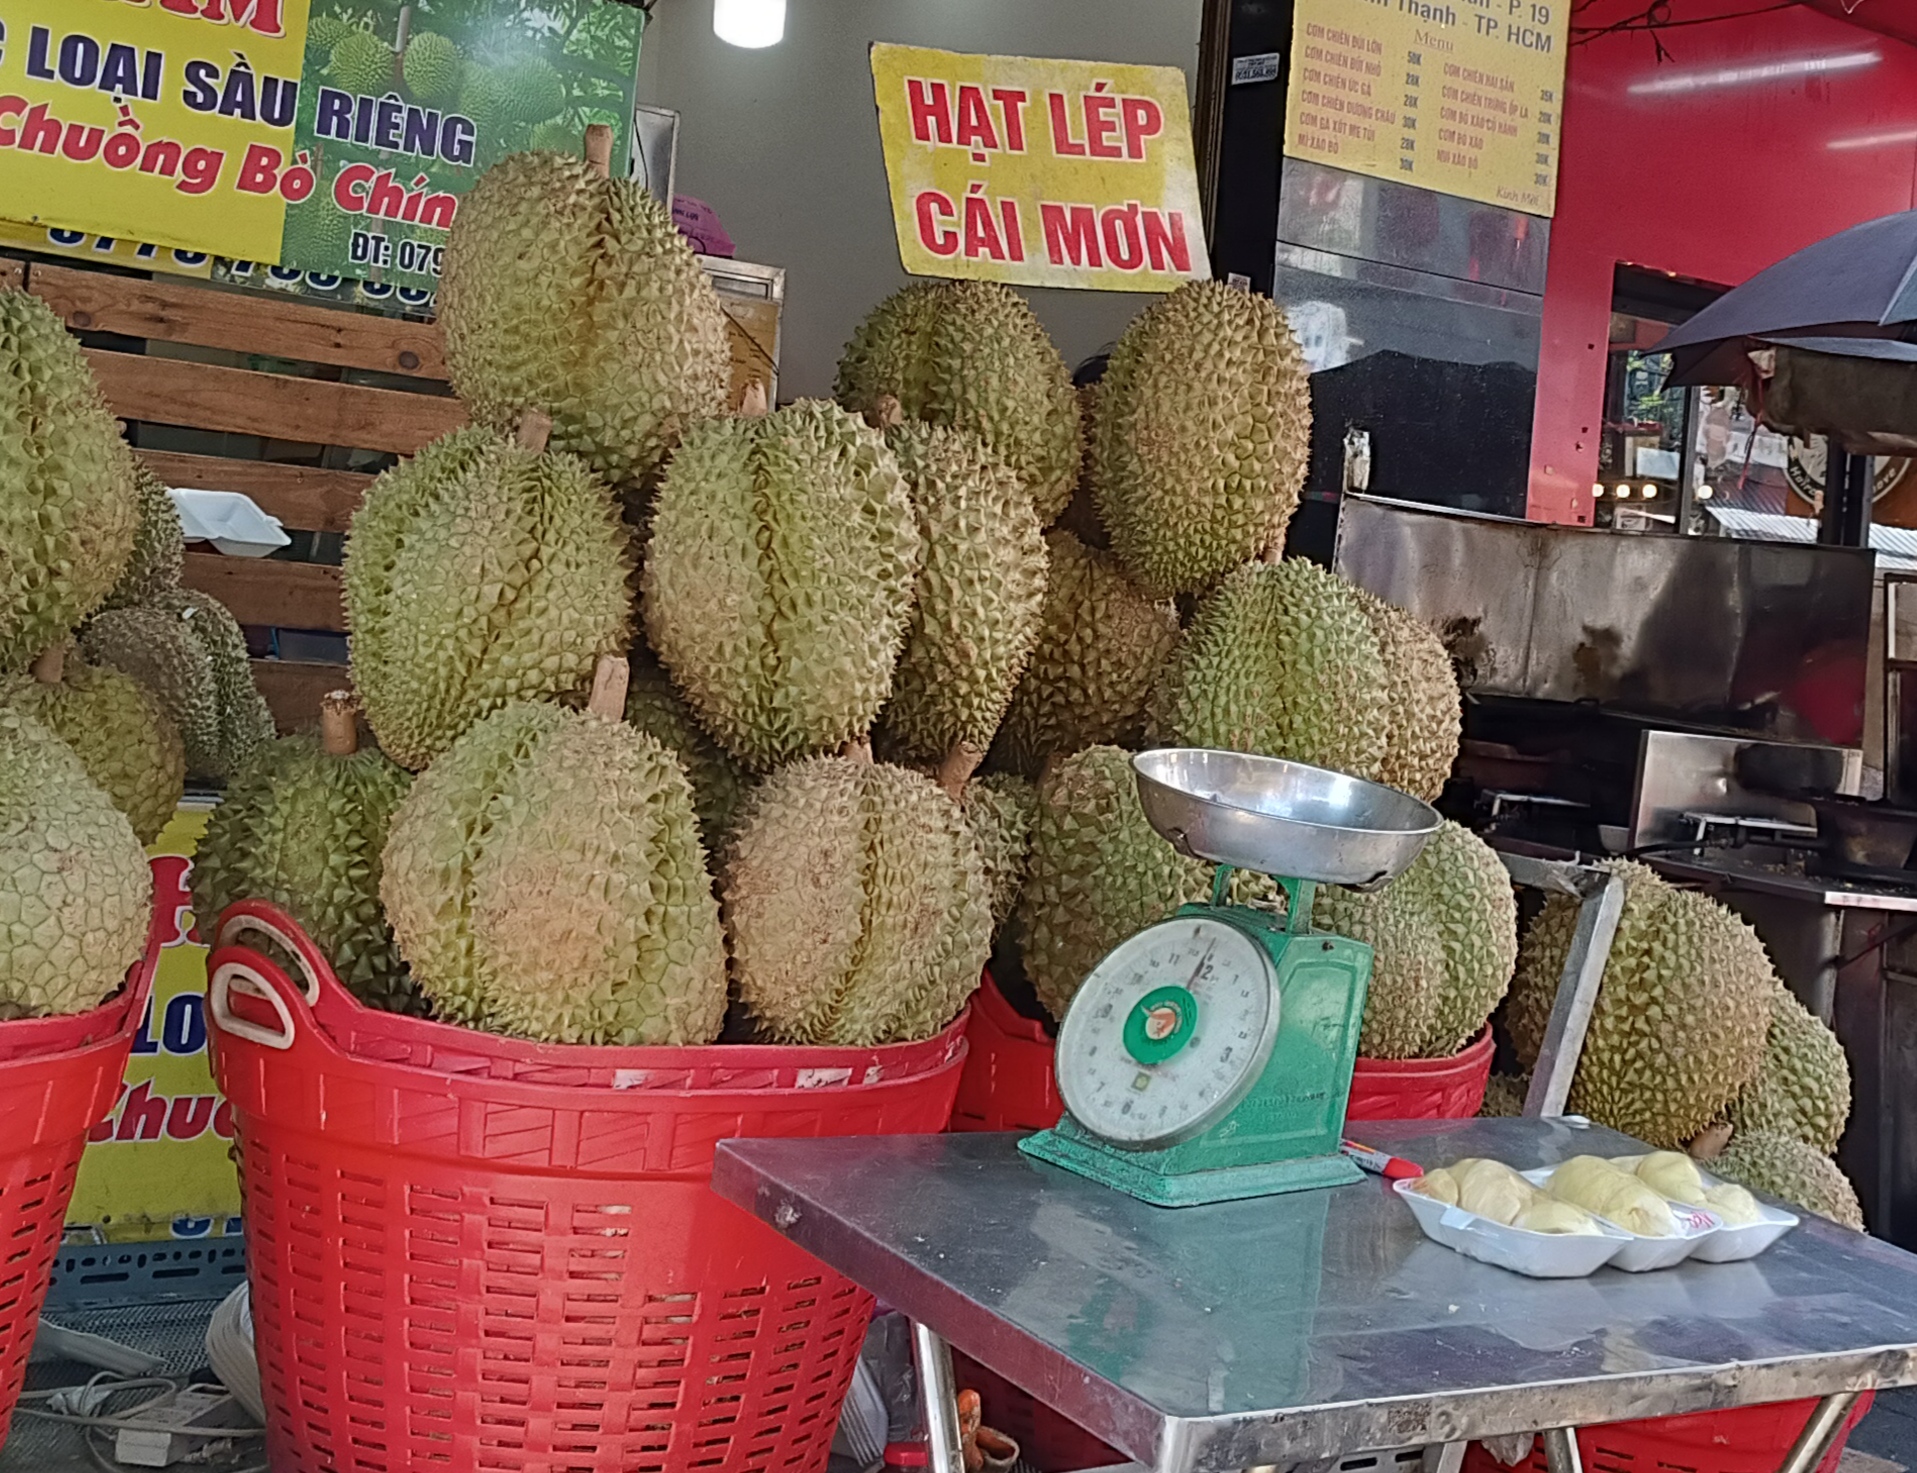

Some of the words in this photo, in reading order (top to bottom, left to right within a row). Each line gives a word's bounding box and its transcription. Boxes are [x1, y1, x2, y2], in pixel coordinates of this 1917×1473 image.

[1474, 13, 1499, 39] TP.
[1507, 24, 1552, 53] HCM
[1530, 3, 1550, 25] 19
[1414, 29, 1454, 51] Menu
[26, 25, 163, 104] LOẠI
[182, 50, 299, 128] SẦU
[314, 86, 477, 167] RIÊNG
[905, 76, 1028, 165] HẠT
[1047, 79, 1163, 161] LÉP
[235, 142, 316, 203] Bò
[349, 229, 392, 268] ĐT:
[914, 182, 1025, 263] CÁI
[1039, 202, 1193, 273] MƠN
